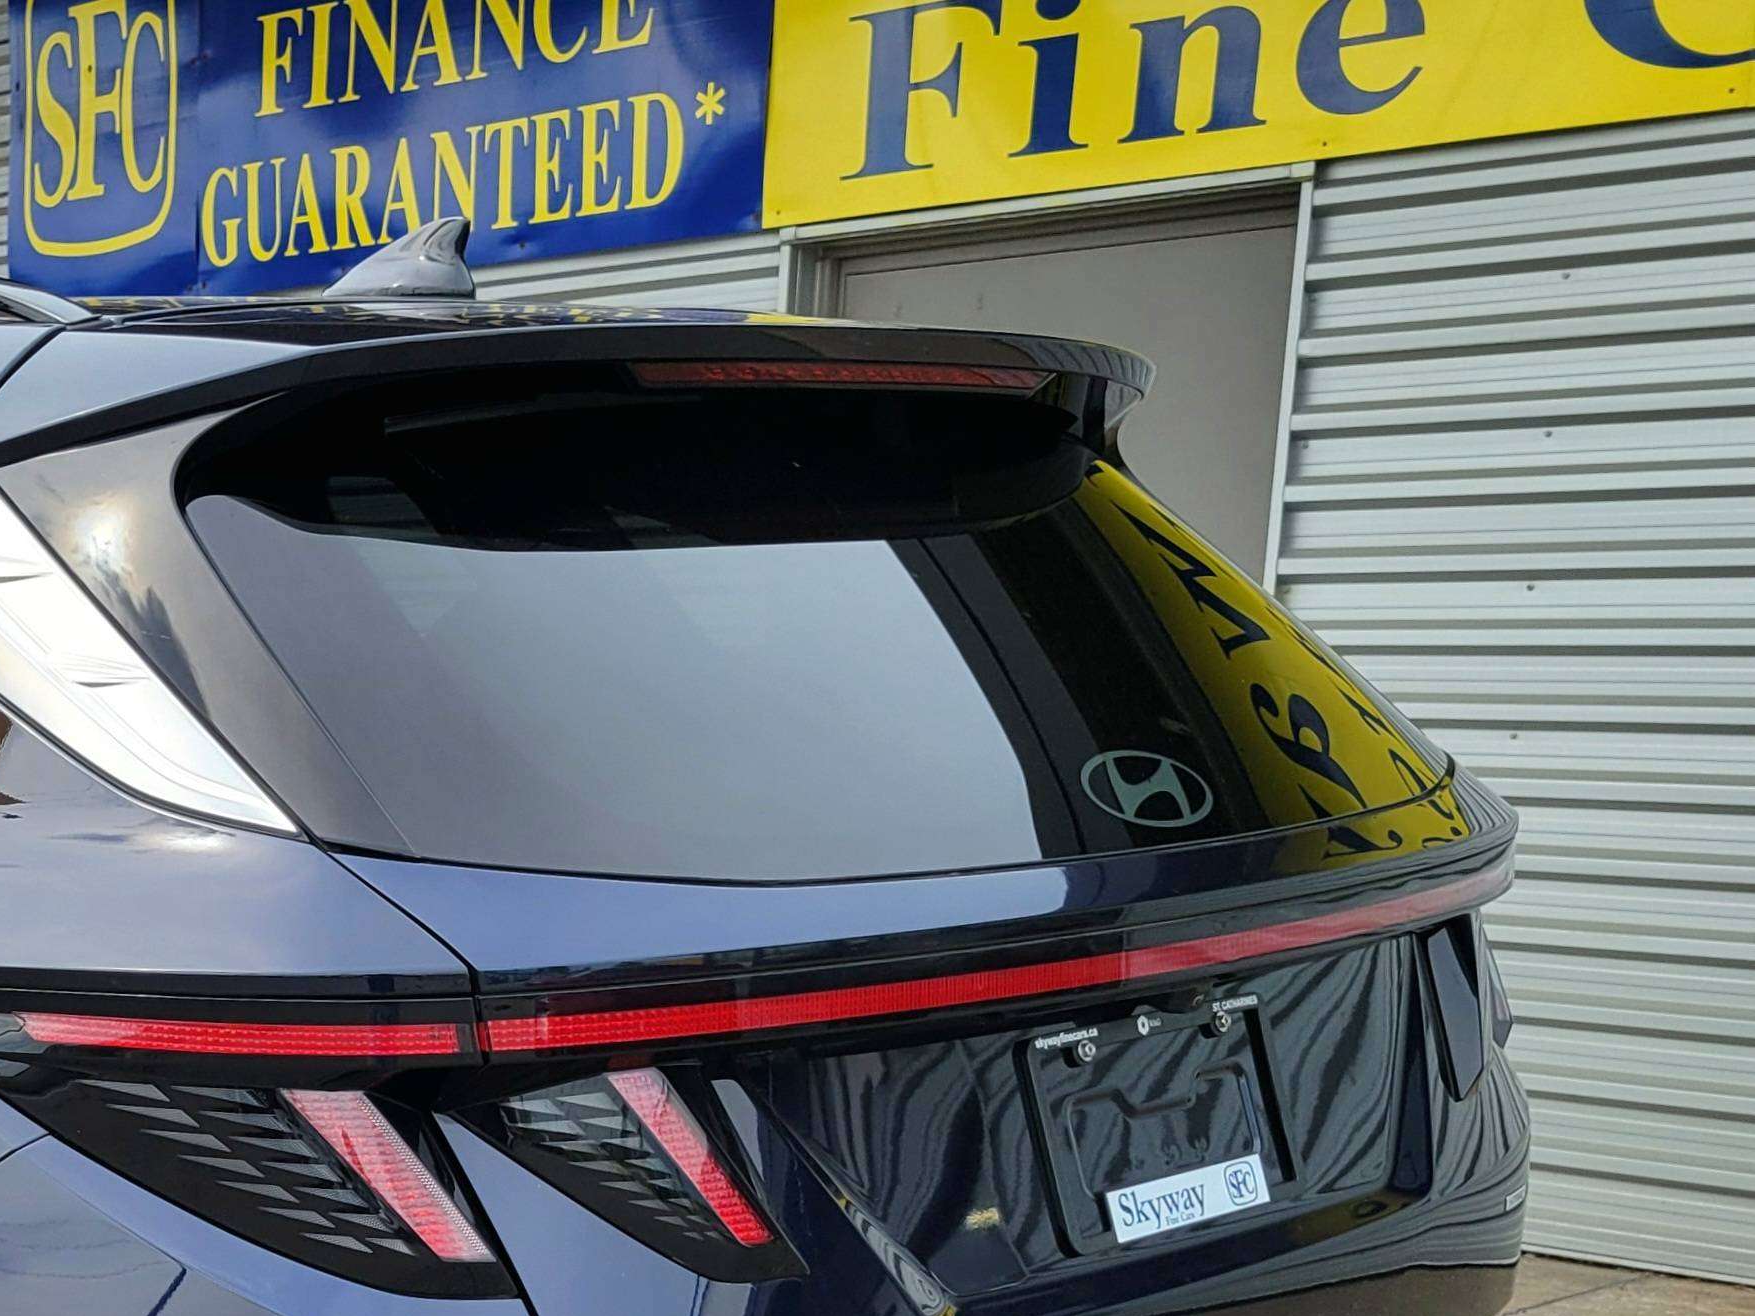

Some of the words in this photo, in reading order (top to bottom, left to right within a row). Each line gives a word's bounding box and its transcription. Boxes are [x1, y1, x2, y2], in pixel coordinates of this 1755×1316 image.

[255, 0, 654, 117] FINANCE
[840, 0, 1425, 181] Fine
[34, 0, 164, 208] SFC
[1118, 1184, 1205, 1229] Skyway
[1180, 1211, 1195, 1221] Cars
[1228, 1169, 1255, 1199] SFC
